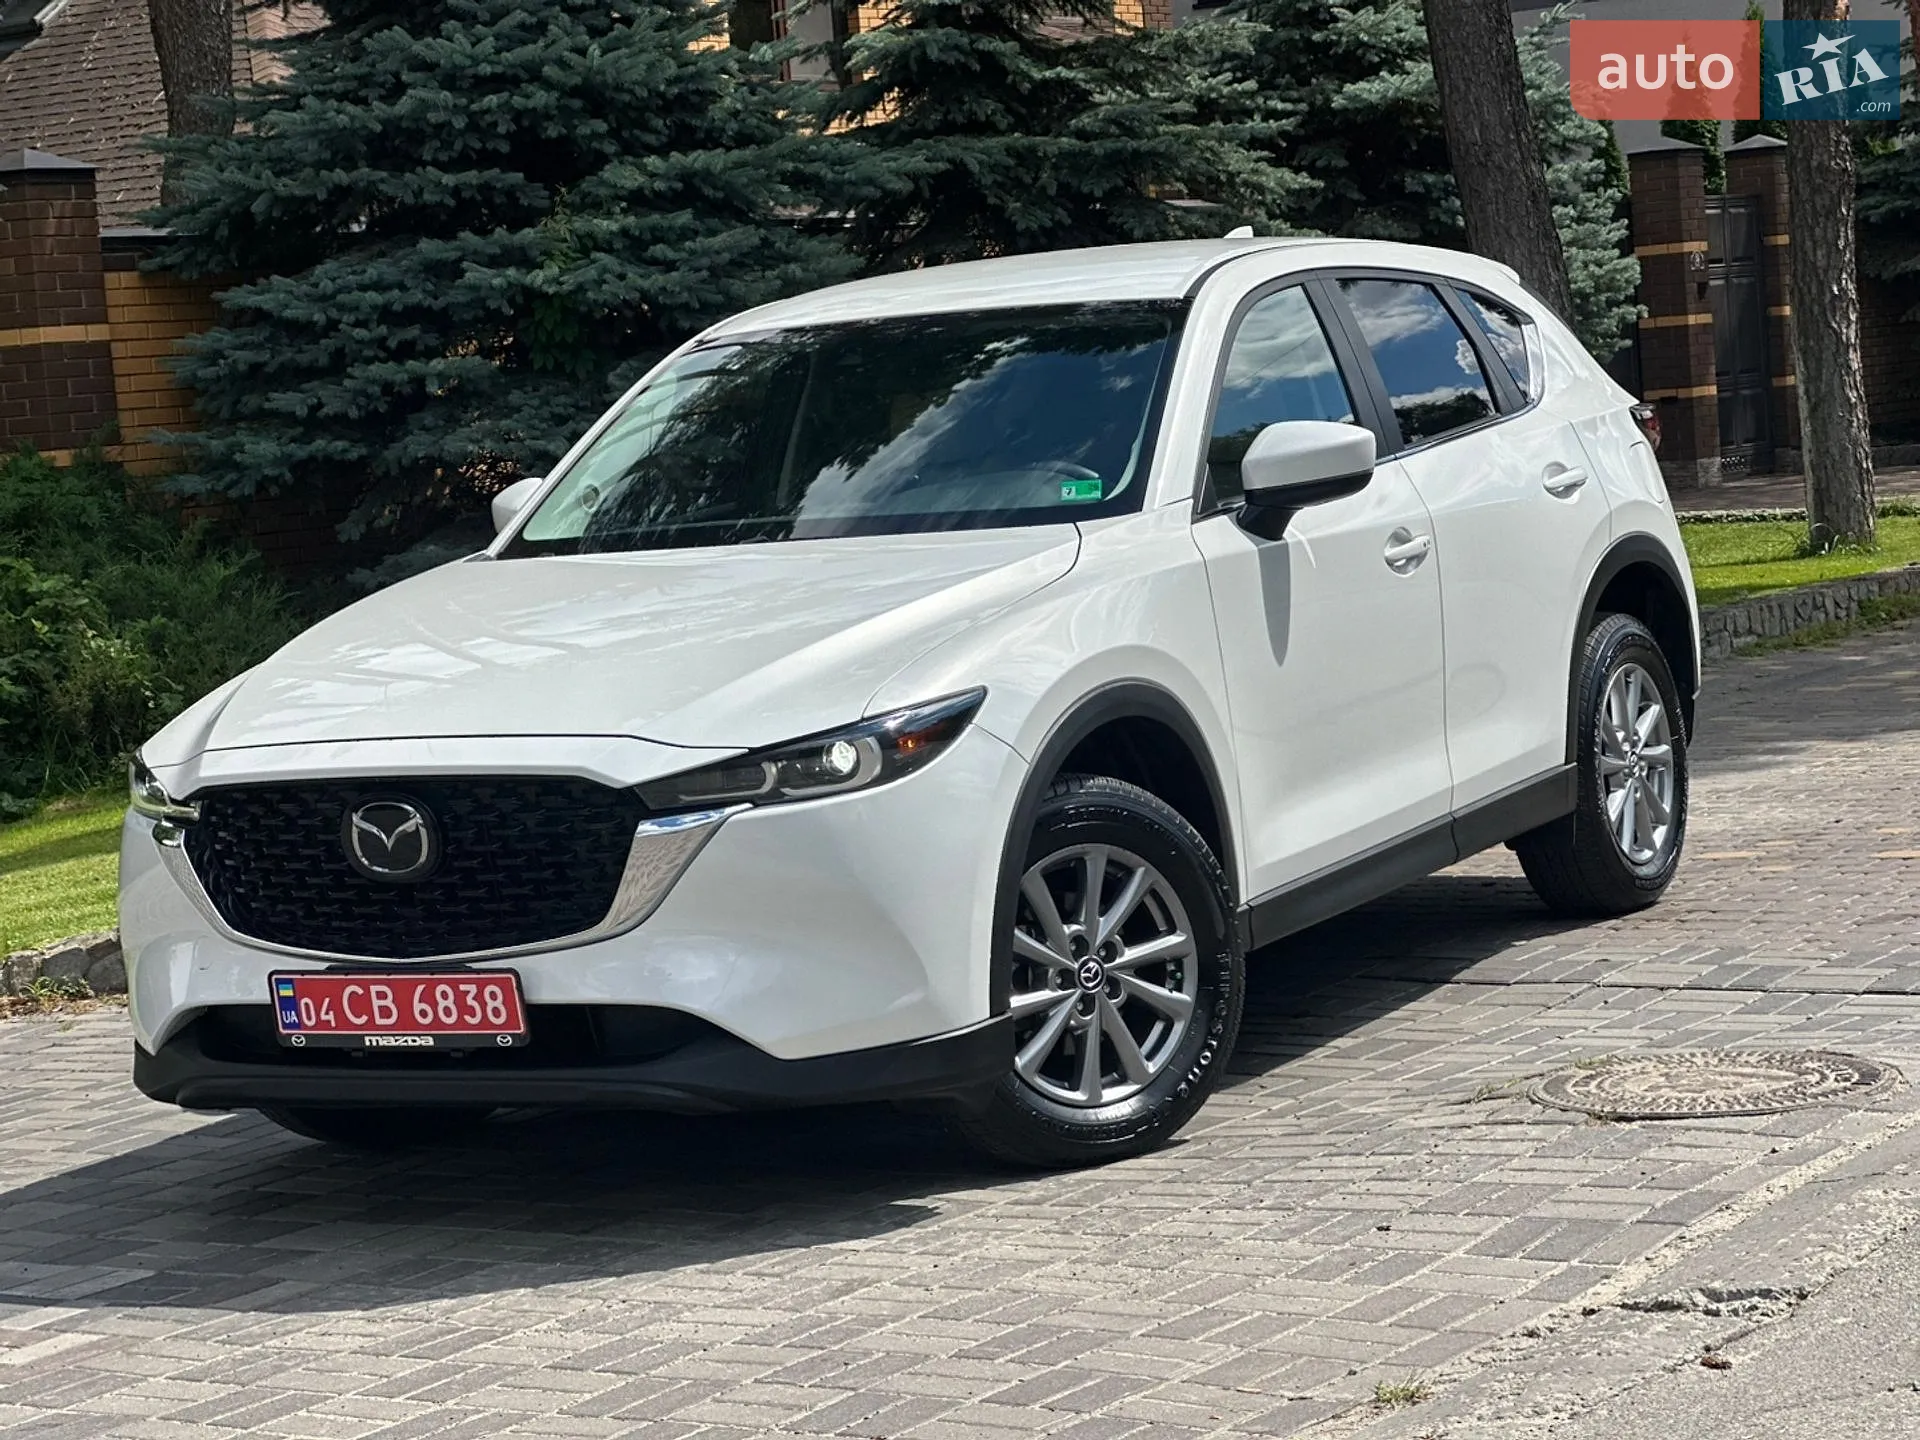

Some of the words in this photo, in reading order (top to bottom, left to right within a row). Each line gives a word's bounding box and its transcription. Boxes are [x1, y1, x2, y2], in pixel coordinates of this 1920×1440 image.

[282, 1010, 299, 1024] UA
[301, 997, 337, 1027] 04
[342, 985, 399, 1026] CB
[412, 984, 508, 1026] 6838
